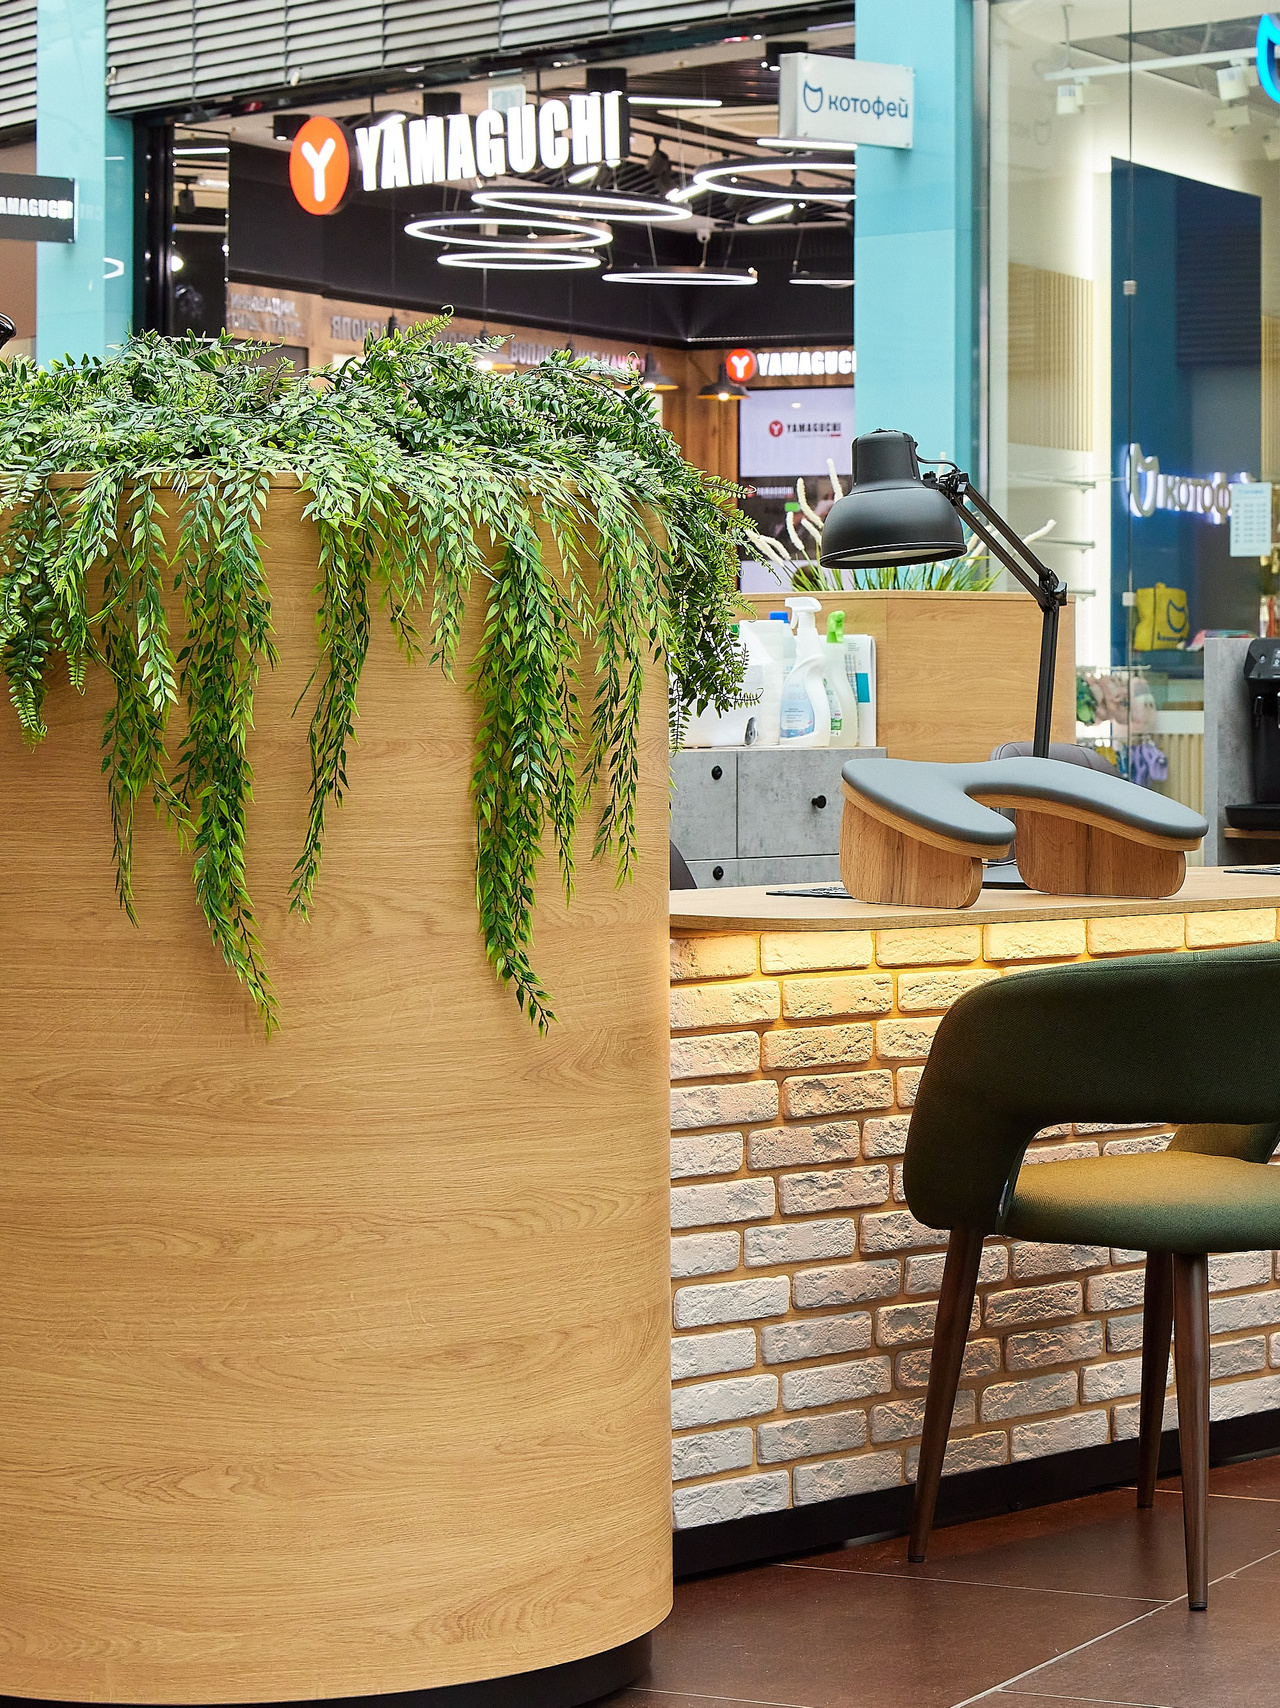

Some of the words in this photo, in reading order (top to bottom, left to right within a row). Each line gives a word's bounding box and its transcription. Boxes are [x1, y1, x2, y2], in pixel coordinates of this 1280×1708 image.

[828, 94, 909, 120] котофей
[355, 94, 621, 192] YAMAGUCHI
[1157, 471, 1245, 525] котоф
